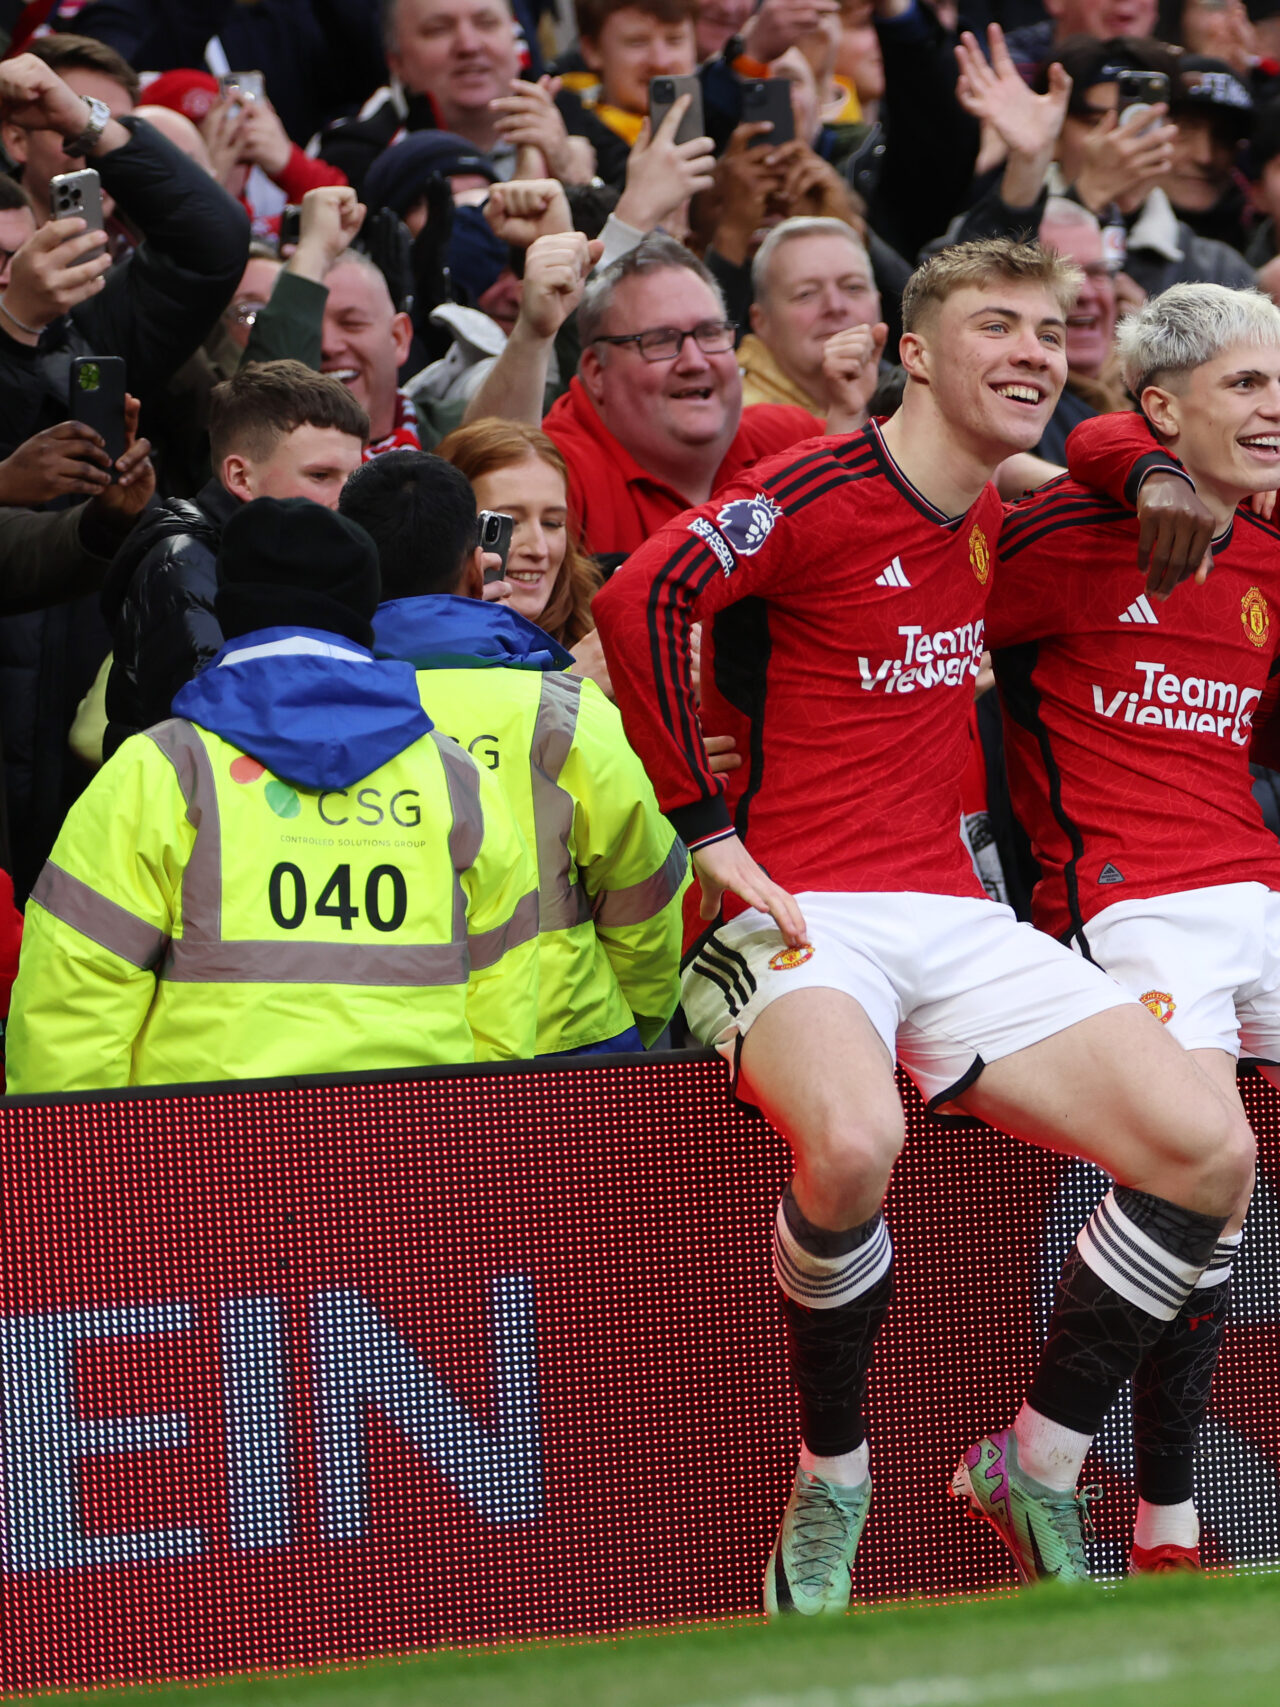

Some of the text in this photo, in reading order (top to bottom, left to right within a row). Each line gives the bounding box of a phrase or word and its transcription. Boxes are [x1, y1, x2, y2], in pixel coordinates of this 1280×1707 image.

[898, 621, 974, 665] Team
[858, 655, 971, 693] Viewer
[1135, 661, 1238, 713] Team
[1092, 684, 1232, 738] Viewer
[318, 788, 421, 828] CSG
[280, 834, 426, 848] CONTROLLED SOLUTIONS GROUP
[268, 862, 408, 932] 040
[0, 1274, 542, 1574] EIN
